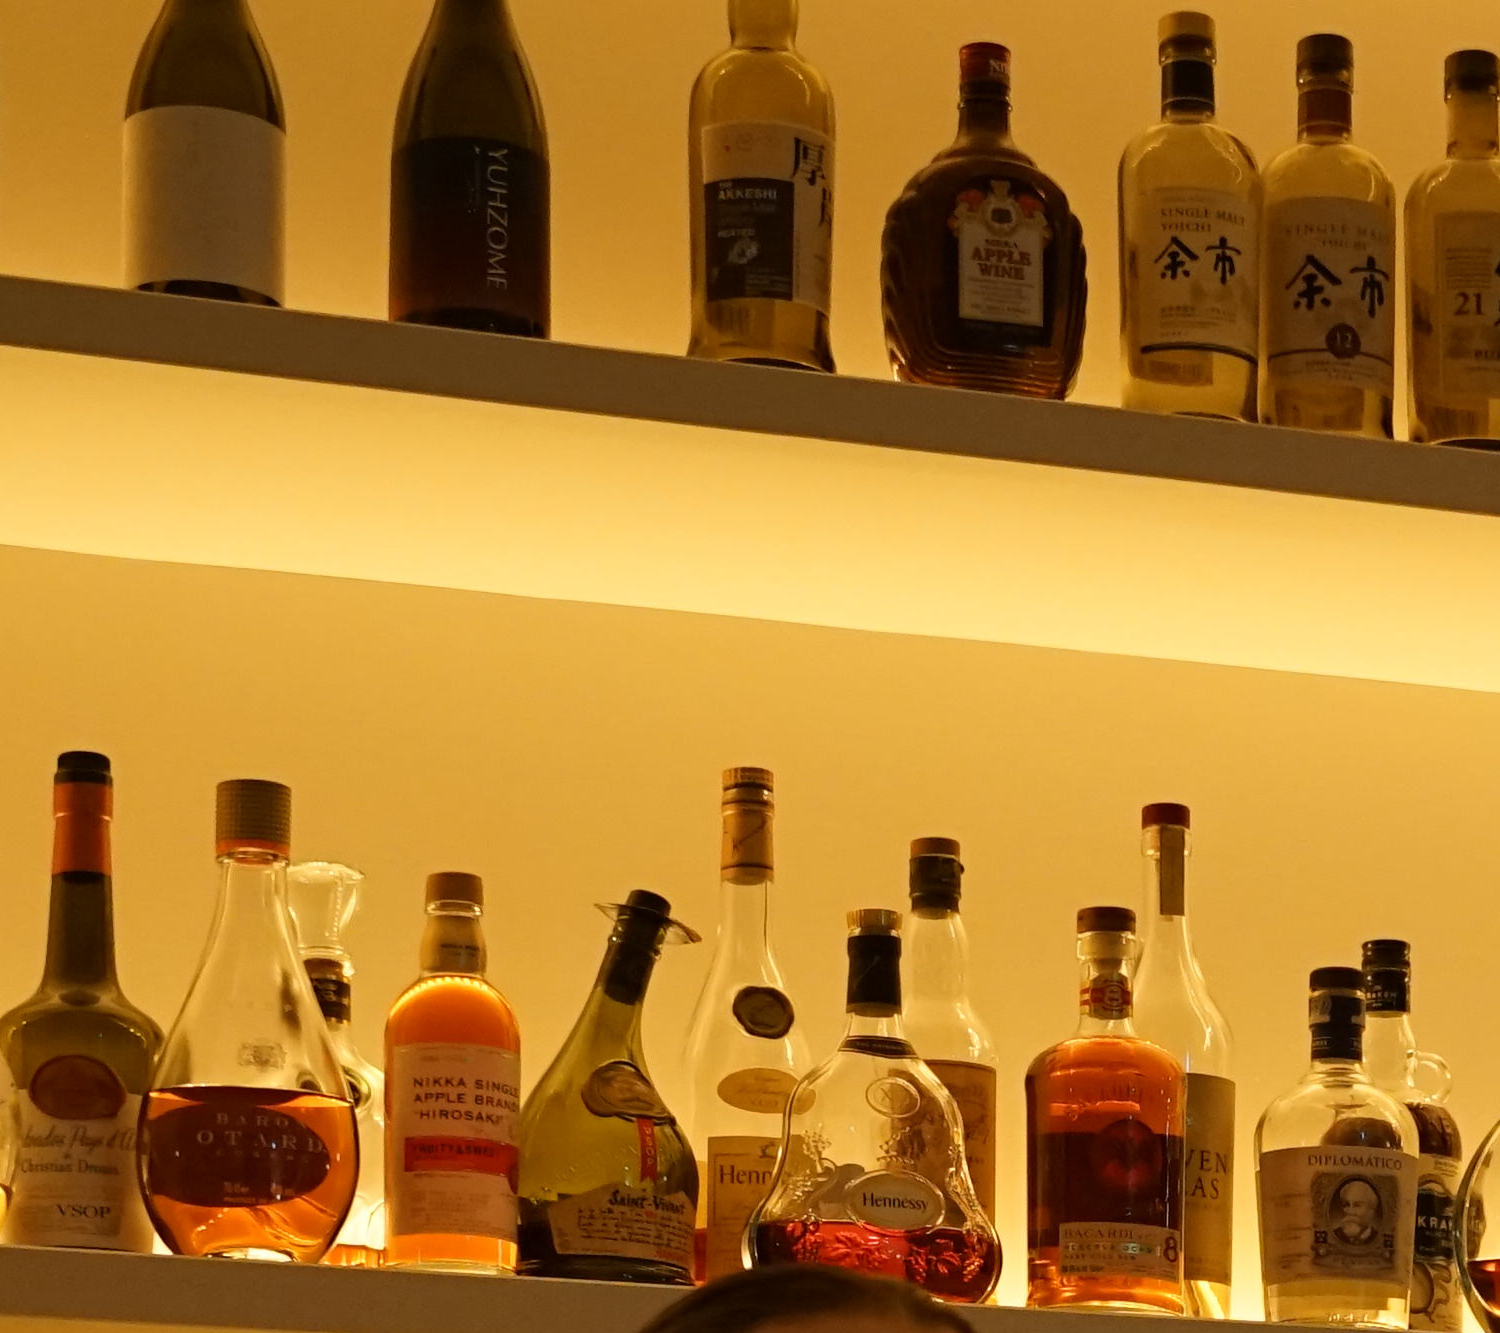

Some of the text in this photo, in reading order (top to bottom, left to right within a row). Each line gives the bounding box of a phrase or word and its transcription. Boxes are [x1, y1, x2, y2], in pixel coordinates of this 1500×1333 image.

[483, 150, 509, 290] YUHZOME
[971, 249, 1031, 266] APPLE
[1154, 235, 1243, 286] 余市
[979, 264, 1025, 283] WINE
[1285, 254, 1390, 319] 余市
[1453, 290, 1485, 318] 21
[412, 1076, 467, 1090] NIKKA
[412, 1092, 466, 1107] APPLE
[196, 1130, 326, 1153] OTARD
[55, 1203, 112, 1221] VSOP
[861, 1191, 930, 1214] Hennessy
[1162, 1236, 1181, 1265] 8
